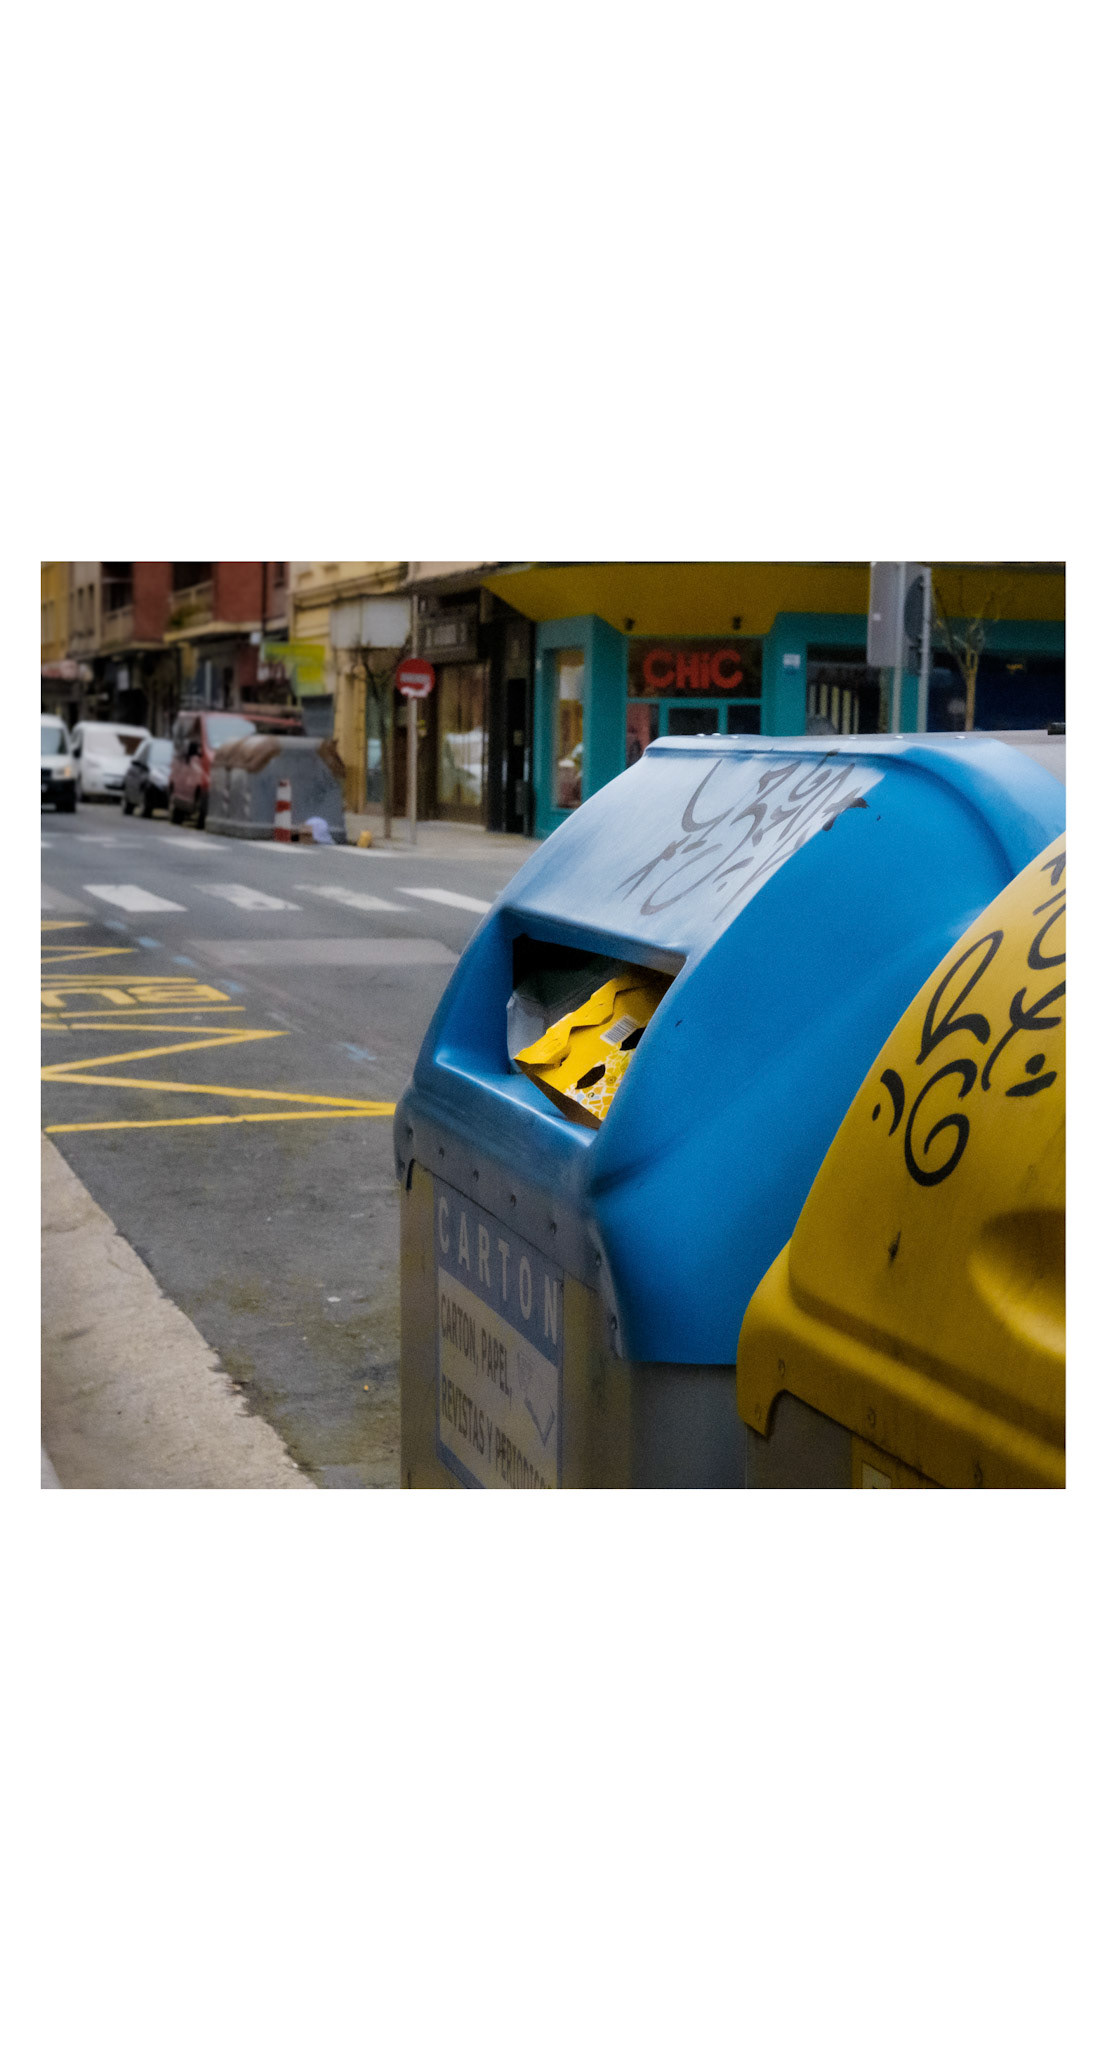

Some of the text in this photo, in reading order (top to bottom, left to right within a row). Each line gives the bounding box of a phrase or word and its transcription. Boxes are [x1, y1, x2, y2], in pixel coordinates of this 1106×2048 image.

[438, 1196, 558, 1346] CARTON
[441, 1293, 513, 1411] CARTON, PAPEL,
[441, 1372, 485, 1456] REVISTAS
[486, 1416, 493, 1464] Y
